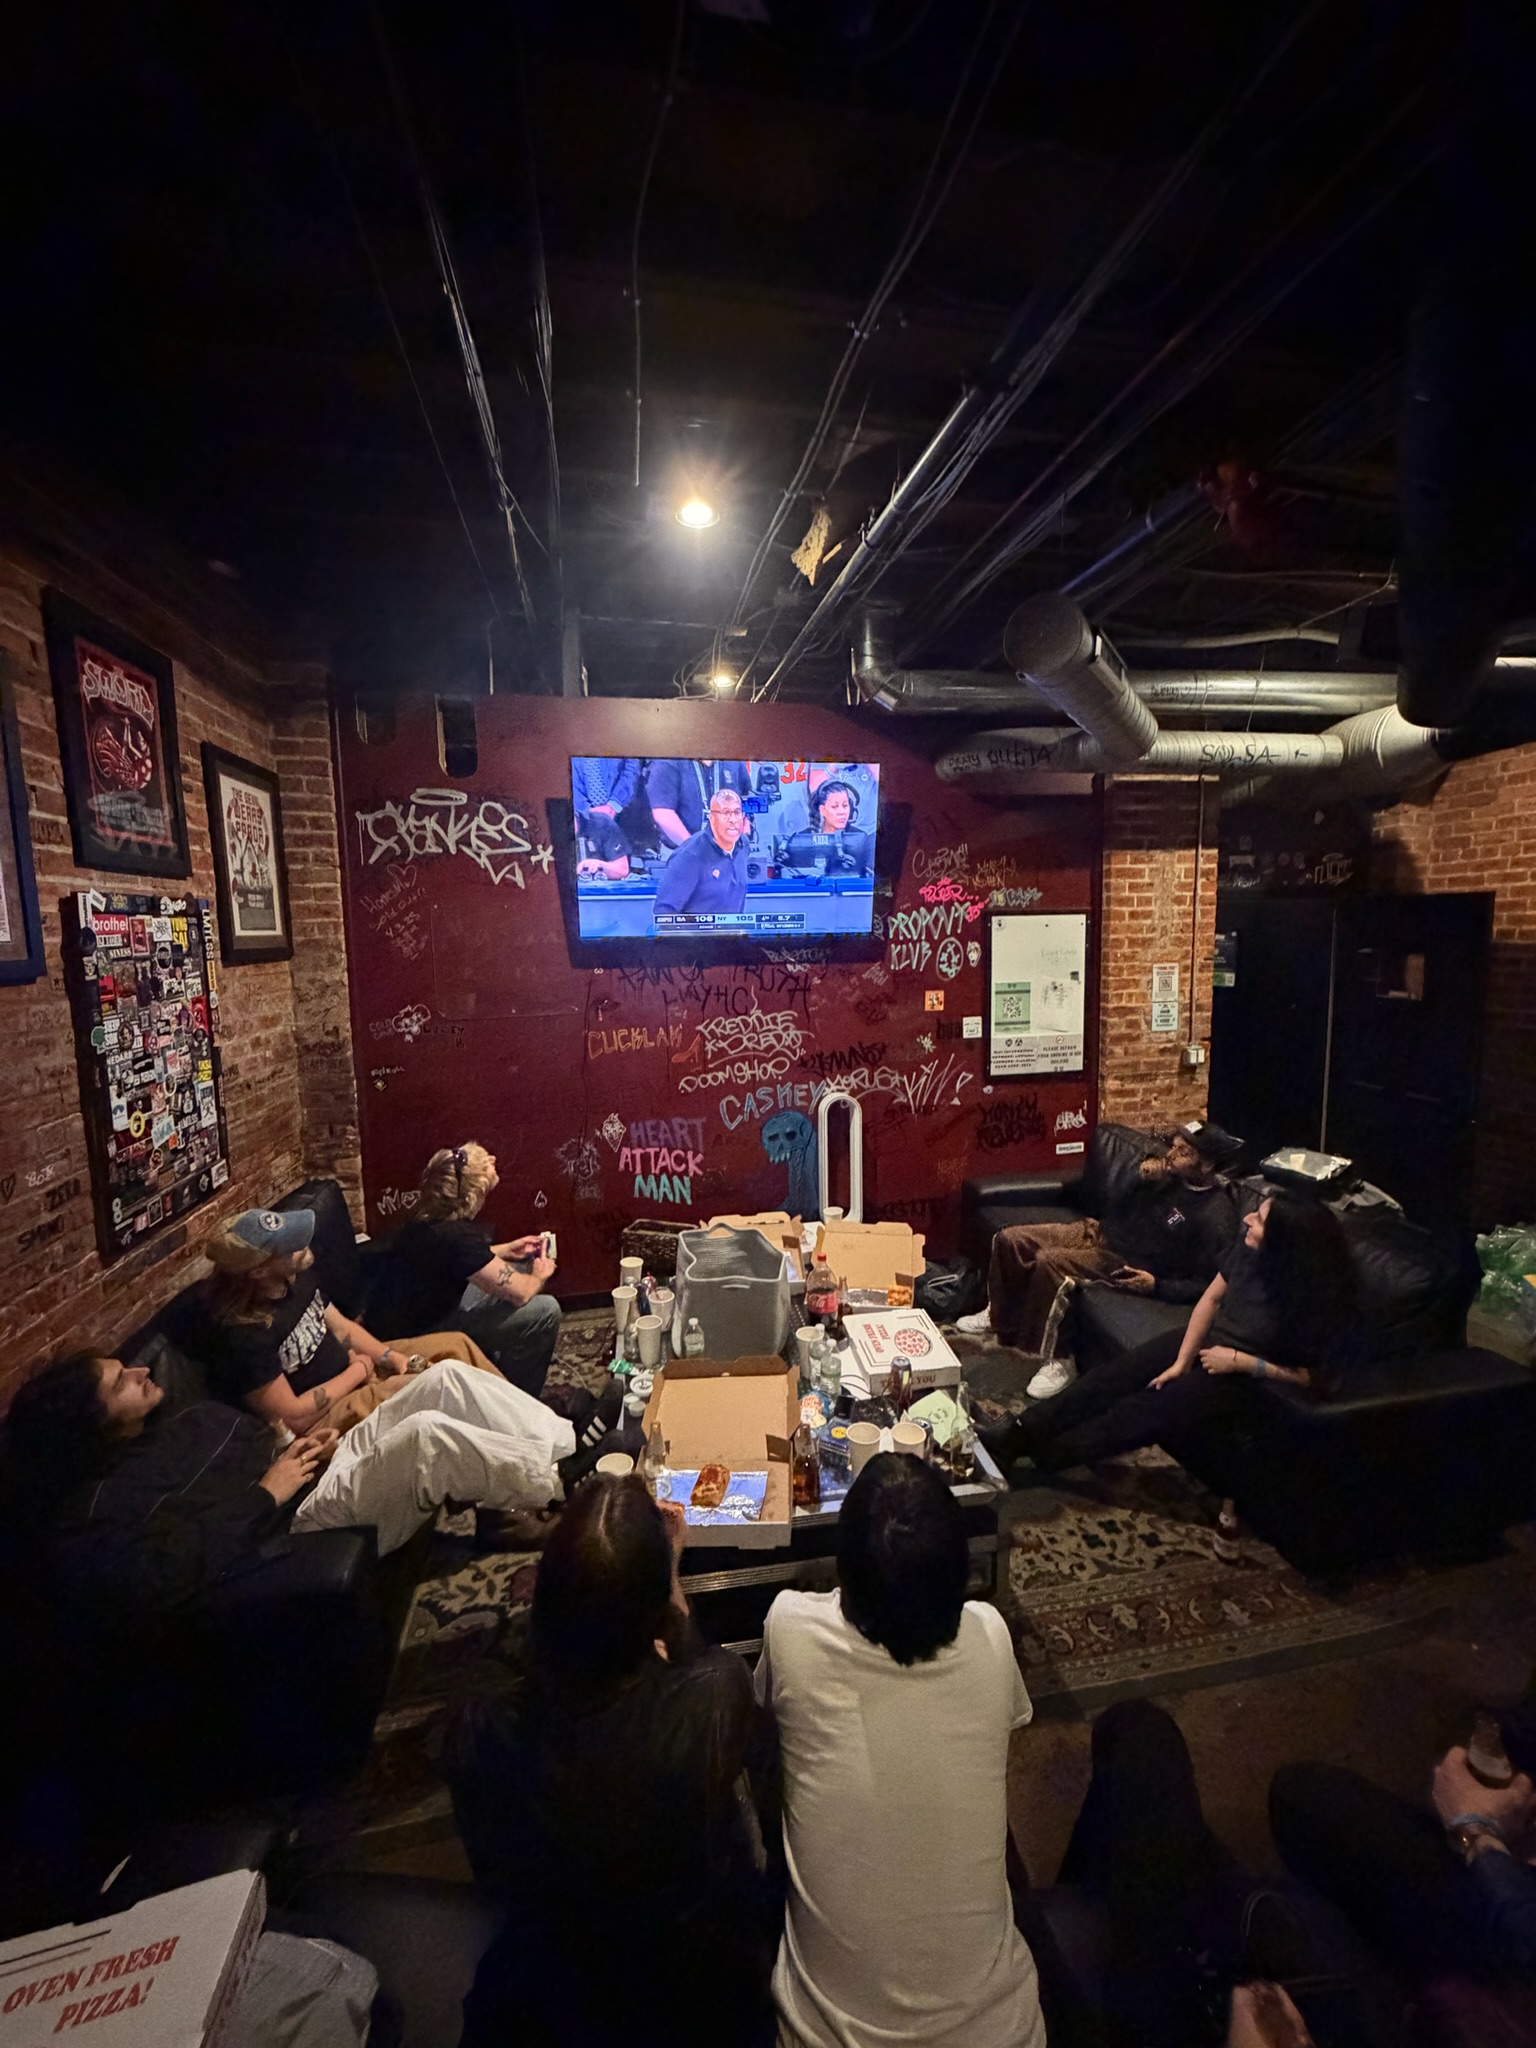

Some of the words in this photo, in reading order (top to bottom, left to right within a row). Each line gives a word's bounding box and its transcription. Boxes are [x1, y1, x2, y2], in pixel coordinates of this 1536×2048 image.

[92, 916, 129, 932] brothel
[720, 1082, 827, 1130] CASKEY
[630, 1117, 706, 1151] HEART
[619, 1147, 704, 1176] ATTACK
[633, 1173, 692, 1206] MAN
[916, 1374, 937, 1385] YOU
[3, 1966, 87, 2014] OVEN
[86, 1936, 181, 1987] FRESH
[54, 1978, 155, 2034] PIZZA!
